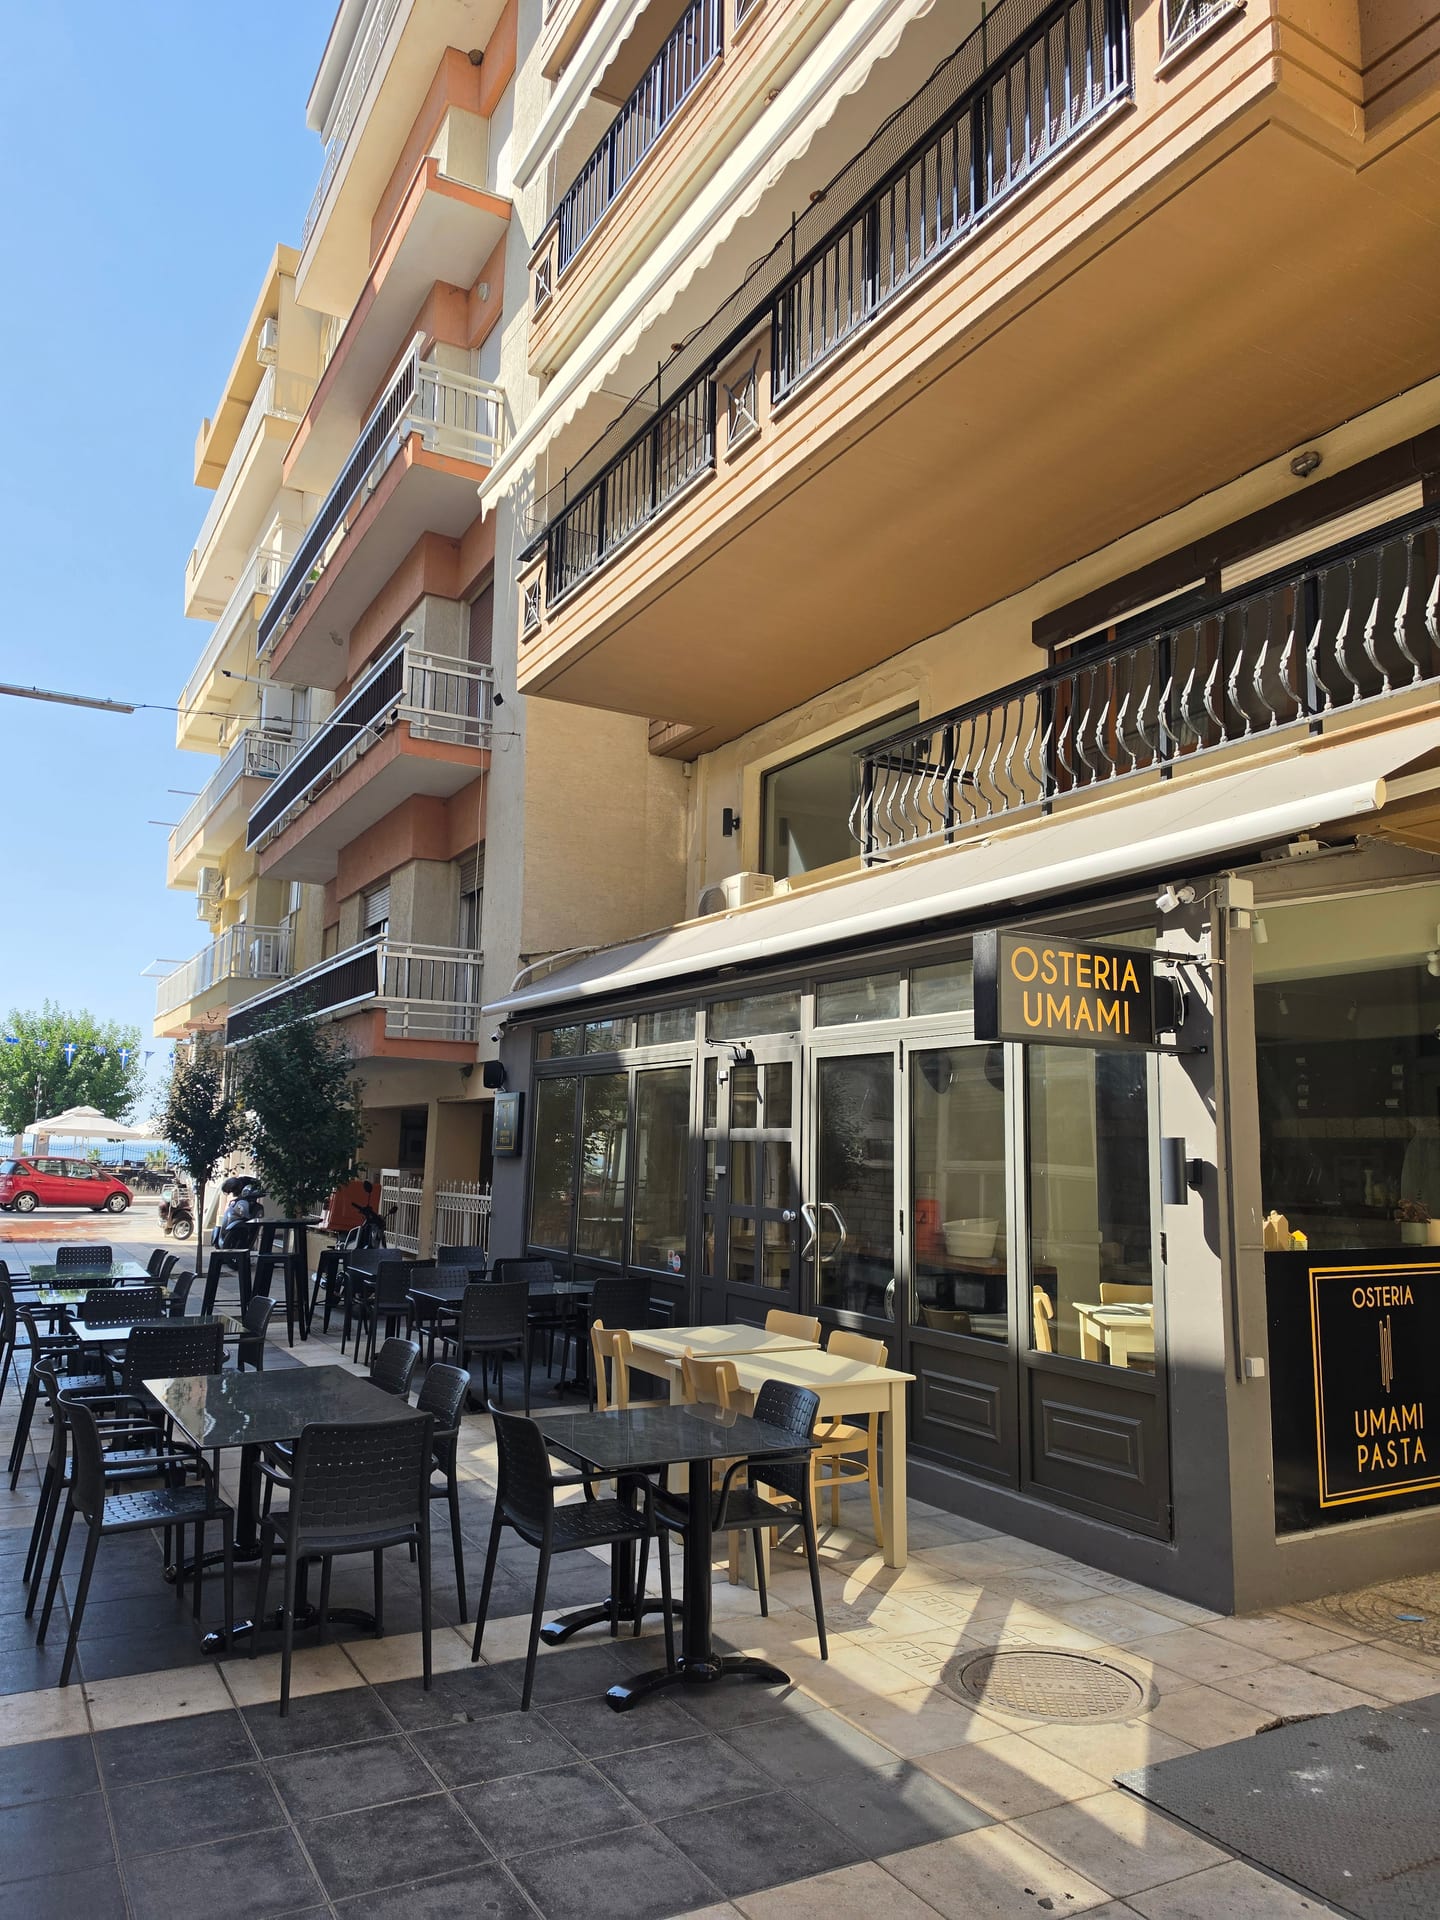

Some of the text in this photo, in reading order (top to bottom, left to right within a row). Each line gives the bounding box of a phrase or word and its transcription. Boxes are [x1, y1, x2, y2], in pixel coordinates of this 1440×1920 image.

[1011, 946, 1140, 993] OSTERIA
[1023, 991, 1129, 1034] UMAMI
[1352, 1285, 1414, 1309] OSTERIA
[1354, 1402, 1424, 1438] UMAMI
[1357, 1436, 1427, 1473] PASTA
